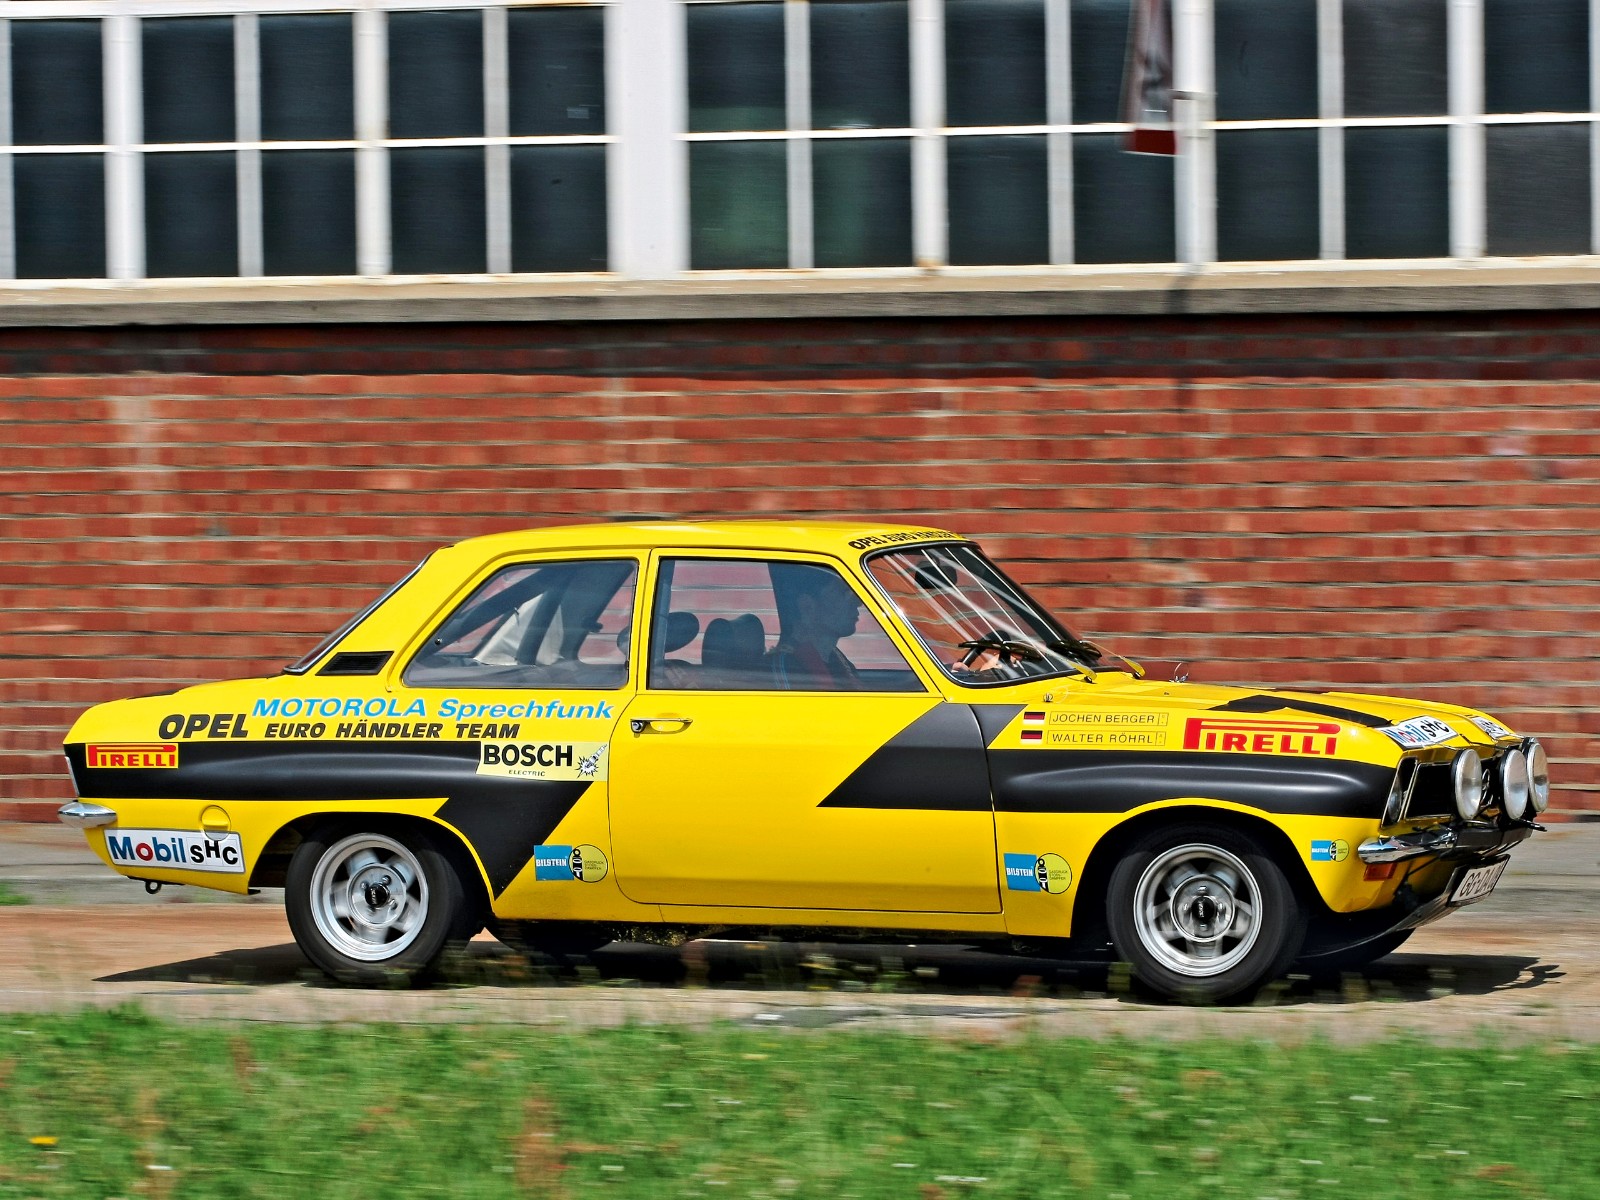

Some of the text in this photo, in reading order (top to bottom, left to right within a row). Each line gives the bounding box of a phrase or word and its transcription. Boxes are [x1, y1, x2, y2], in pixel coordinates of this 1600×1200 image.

[848, 535, 888, 549] OPEL
[251, 698, 614, 721] MOTOROLA Sprechfunk
[1052, 714, 1101, 723] JOCHEN
[1105, 715, 1155, 724] BERGER
[158, 713, 249, 740] OPEL
[264, 719, 521, 739] EURO HÄNDLER TEAM
[1183, 718, 1341, 754] PIRELLI
[1420, 719, 1450, 738] SHC
[1052, 734, 1104, 743] WALTER
[1109, 732, 1153, 743] RÖHRL
[89, 745, 176, 766] PIRELLI
[483, 744, 573, 767] BOSCH
[508, 769, 546, 777] ELECTRIC
[108, 836, 239, 866] Mobil SHC
[536, 858, 567, 867] BILSTEIN
[1006, 867, 1034, 877] BILSTEIN
